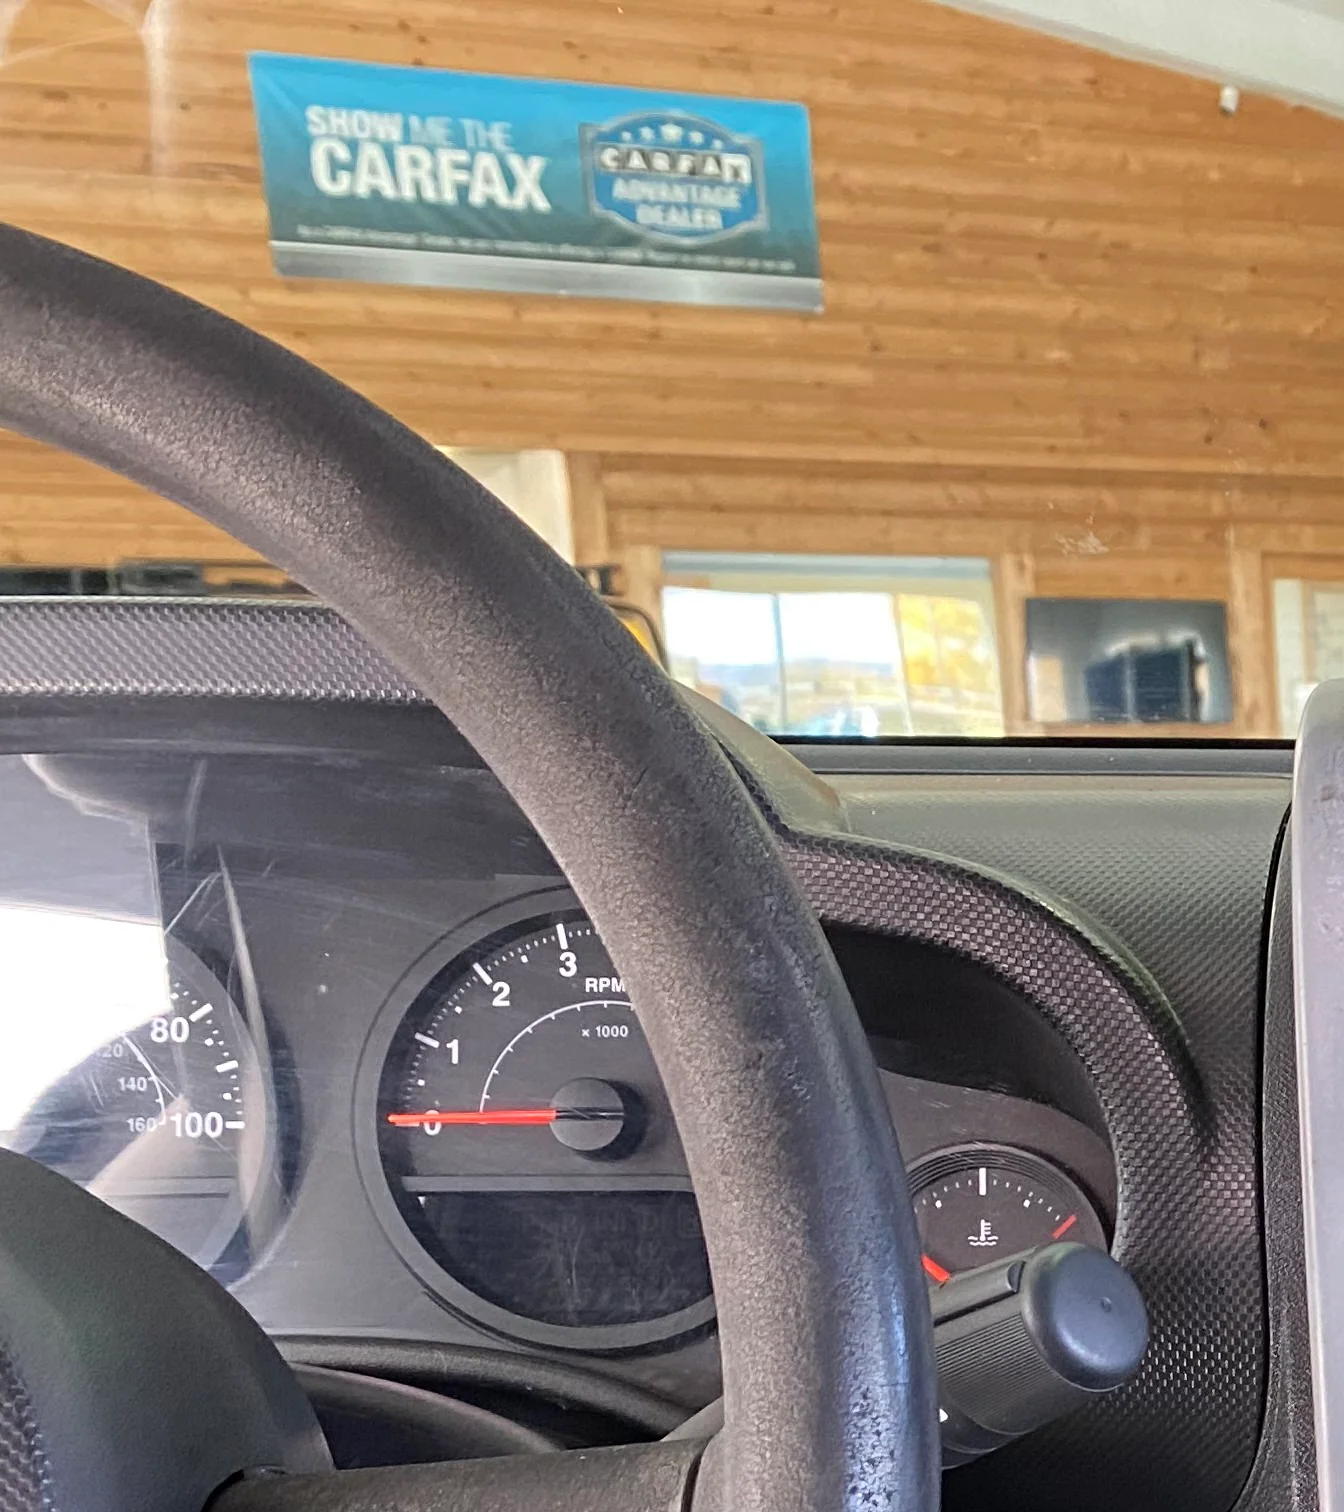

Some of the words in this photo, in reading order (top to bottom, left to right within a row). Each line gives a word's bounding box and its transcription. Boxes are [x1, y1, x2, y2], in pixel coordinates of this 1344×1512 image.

[305, 105, 403, 142] SHOW
[408, 115, 453, 145] ME
[460, 118, 514, 151] THE
[310, 136, 552, 214] CARFAX
[559, 952, 577, 977] 3
[492, 981, 511, 1007] 2
[150, 1016, 190, 1043] 80
[595, 1025, 629, 1038] 1000
[446, 1038, 459, 1065] 1
[117, 1076, 148, 1092] 140
[126, 1117, 158, 1133] 160
[170, 1111, 224, 1138] 100
